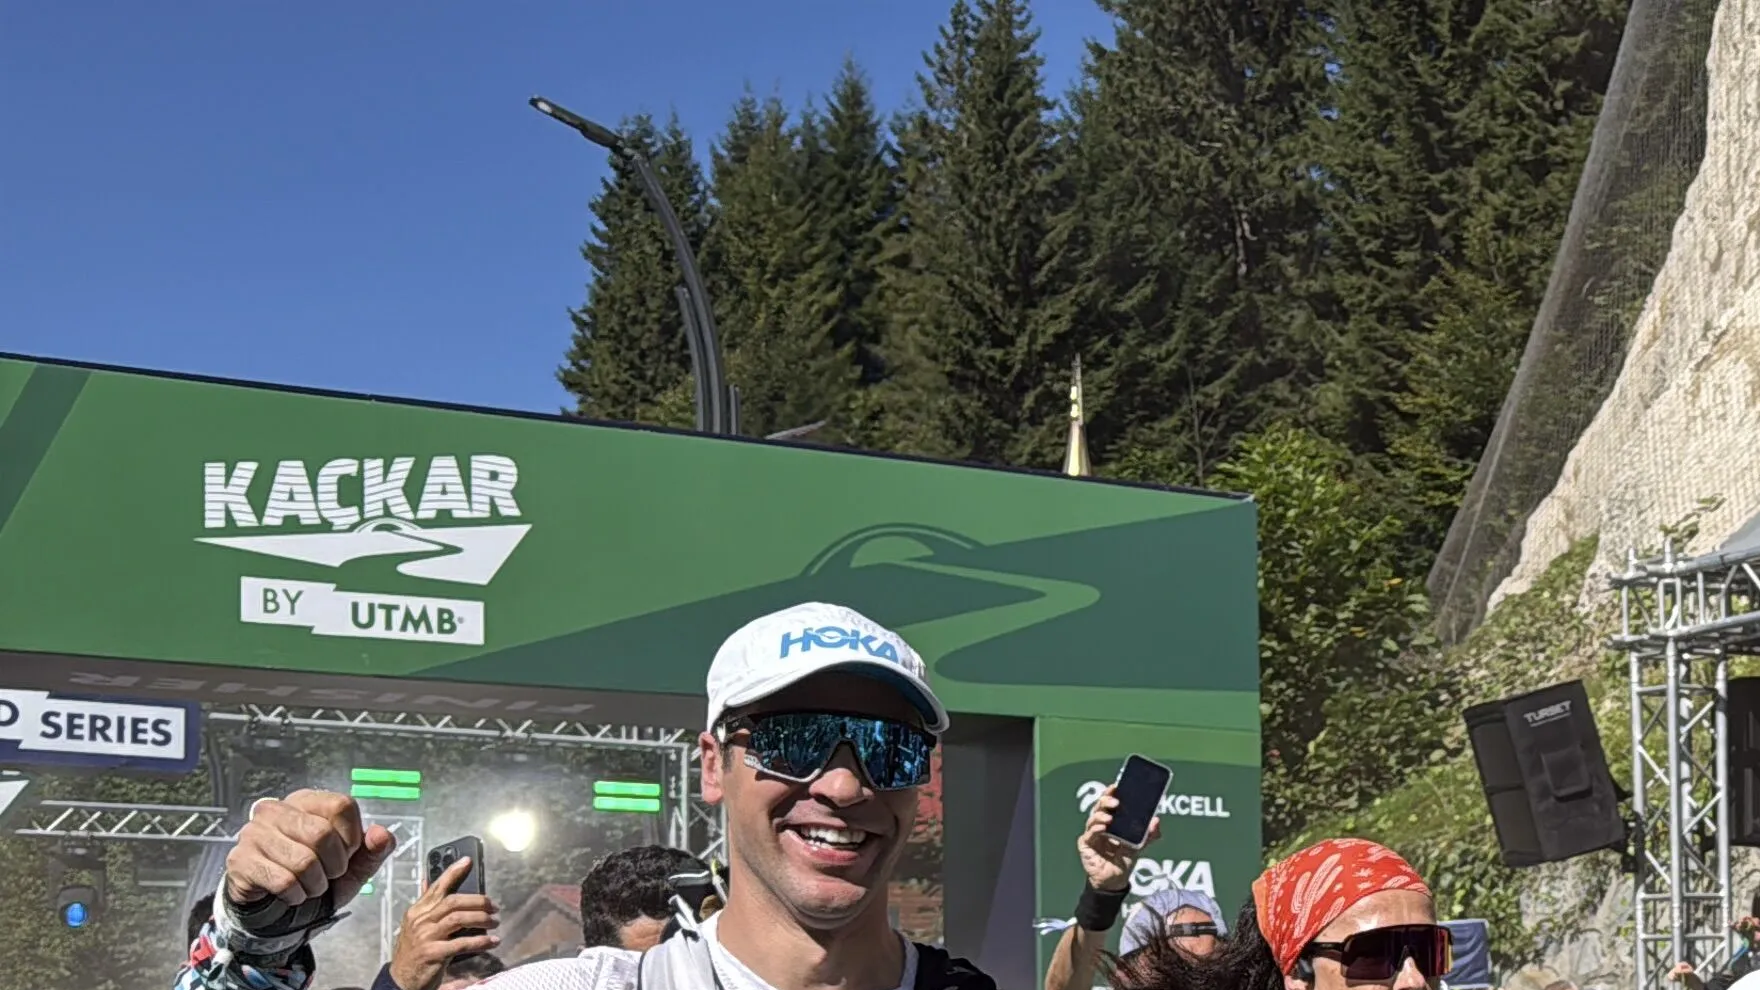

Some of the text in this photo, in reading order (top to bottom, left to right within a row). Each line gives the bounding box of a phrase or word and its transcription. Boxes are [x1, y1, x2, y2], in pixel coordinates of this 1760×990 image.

[204, 455, 522, 530] KAÇKAR
[262, 587, 458, 636] BY UTMB
[780, 625, 899, 663] HOKA
[40, 710, 173, 746] SERIES
[1157, 795, 1231, 818] KCELL
[1130, 858, 1216, 898] OKA
